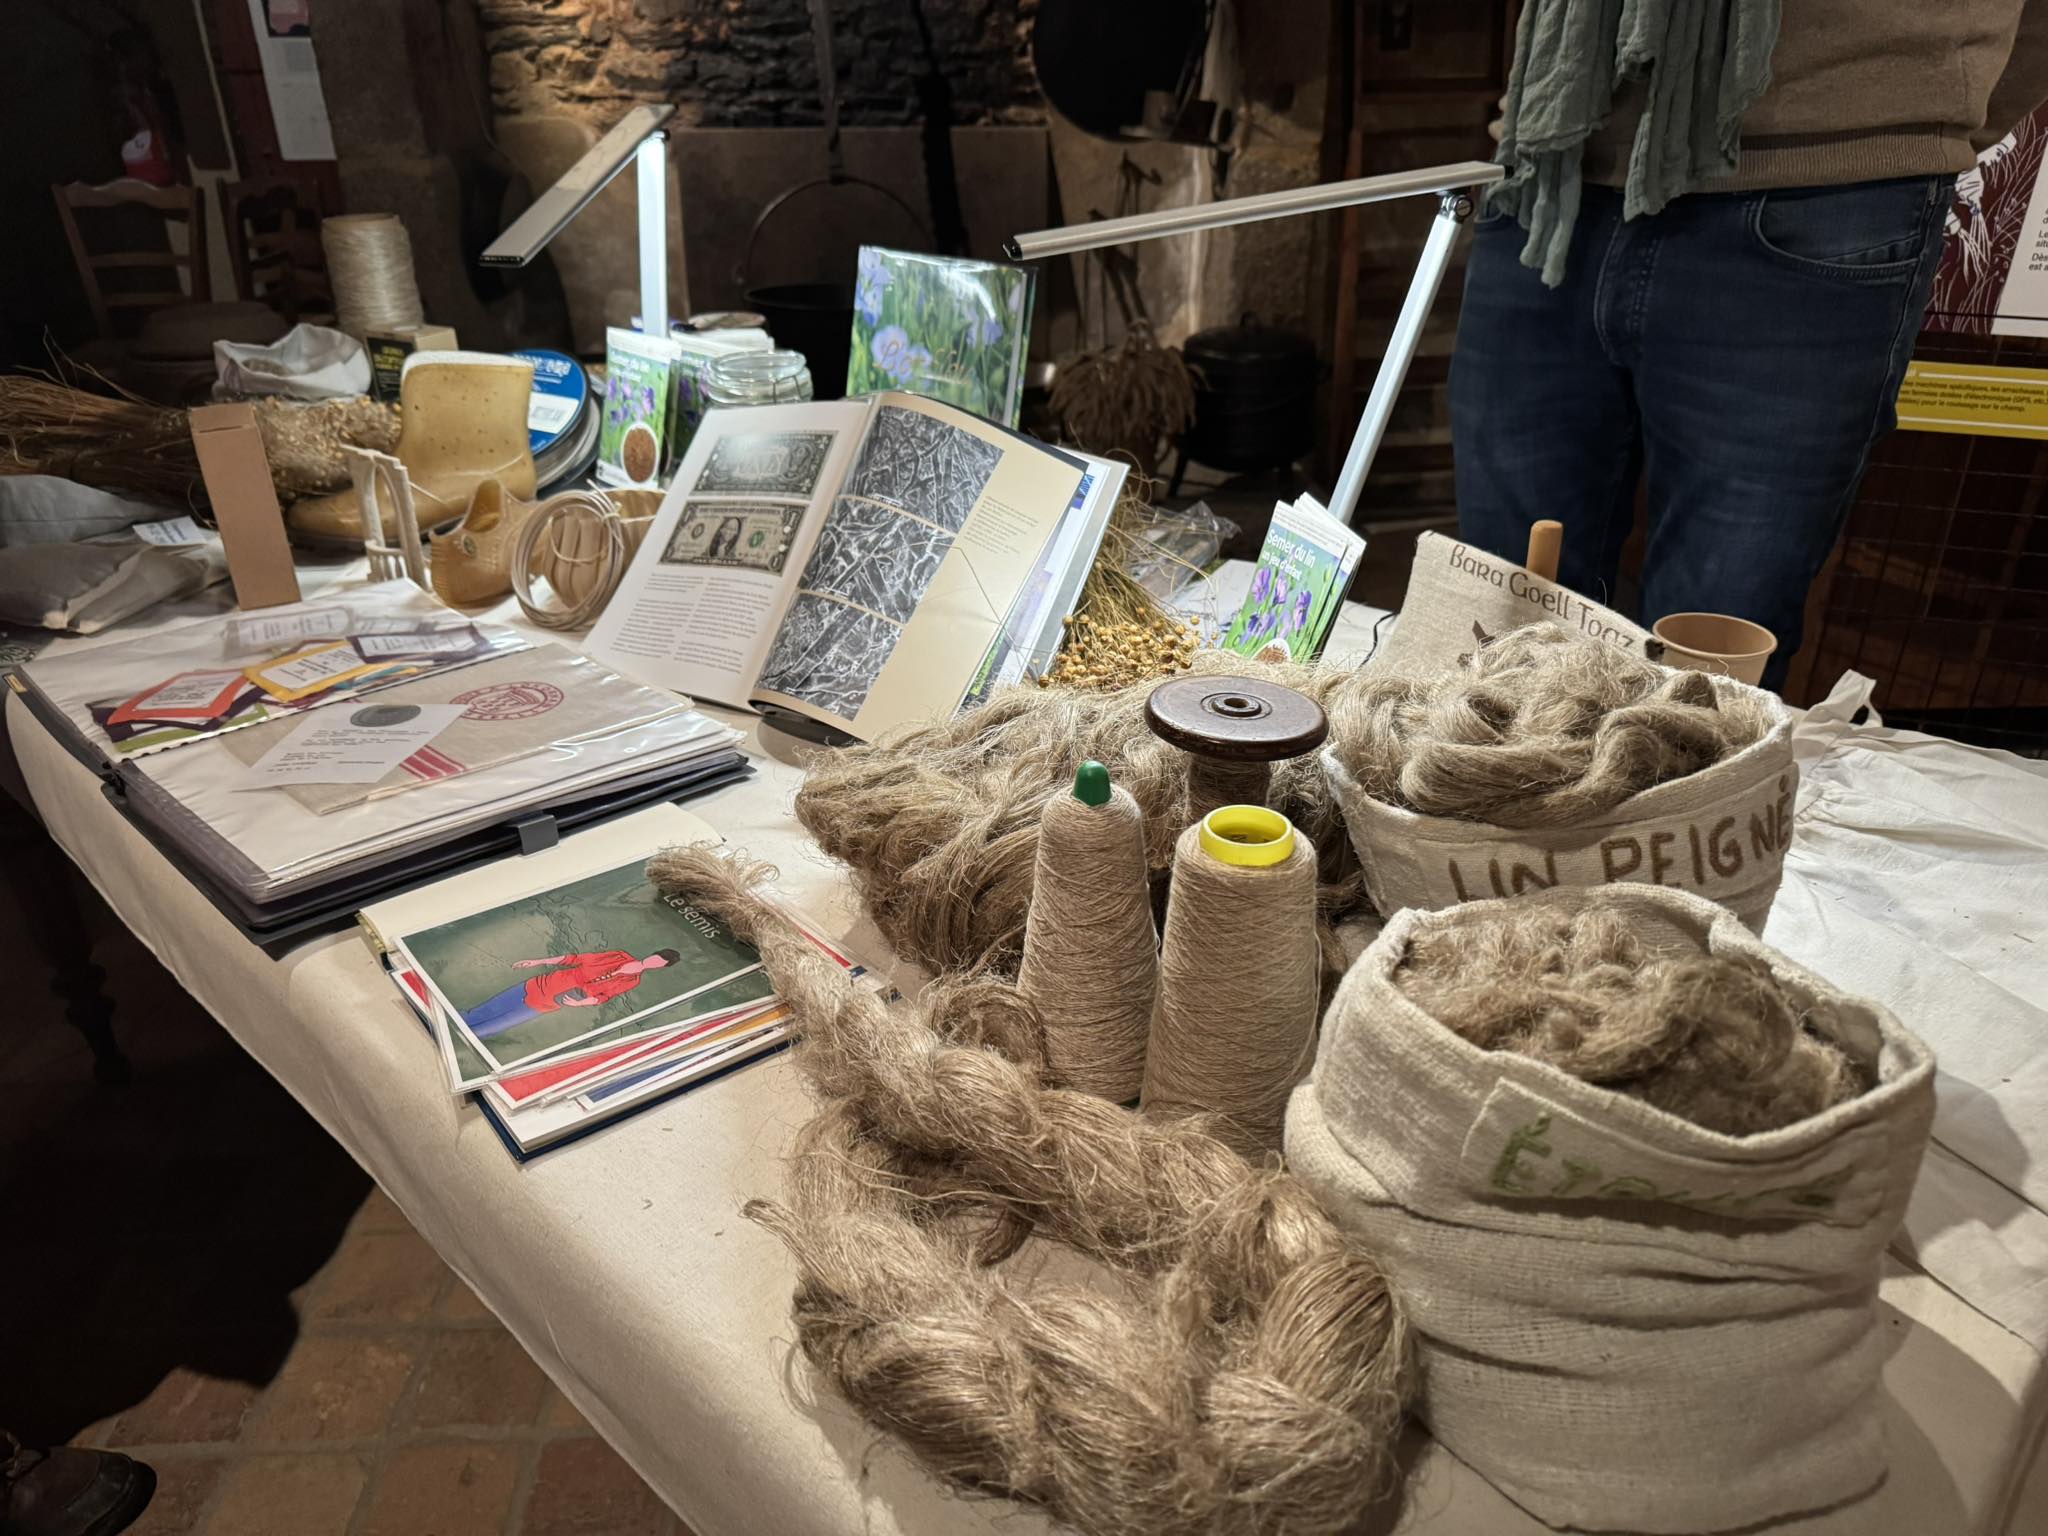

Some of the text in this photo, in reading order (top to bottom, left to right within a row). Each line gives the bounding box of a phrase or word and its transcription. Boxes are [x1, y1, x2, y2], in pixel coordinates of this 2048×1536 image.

[1267, 529, 1316, 569] Semer du lin
[1449, 543, 1504, 588] Bara
[1509, 571, 1570, 621] Goell
[1600, 775, 1792, 888] PEIGNÉ
[663, 893, 721, 939] Le semis
